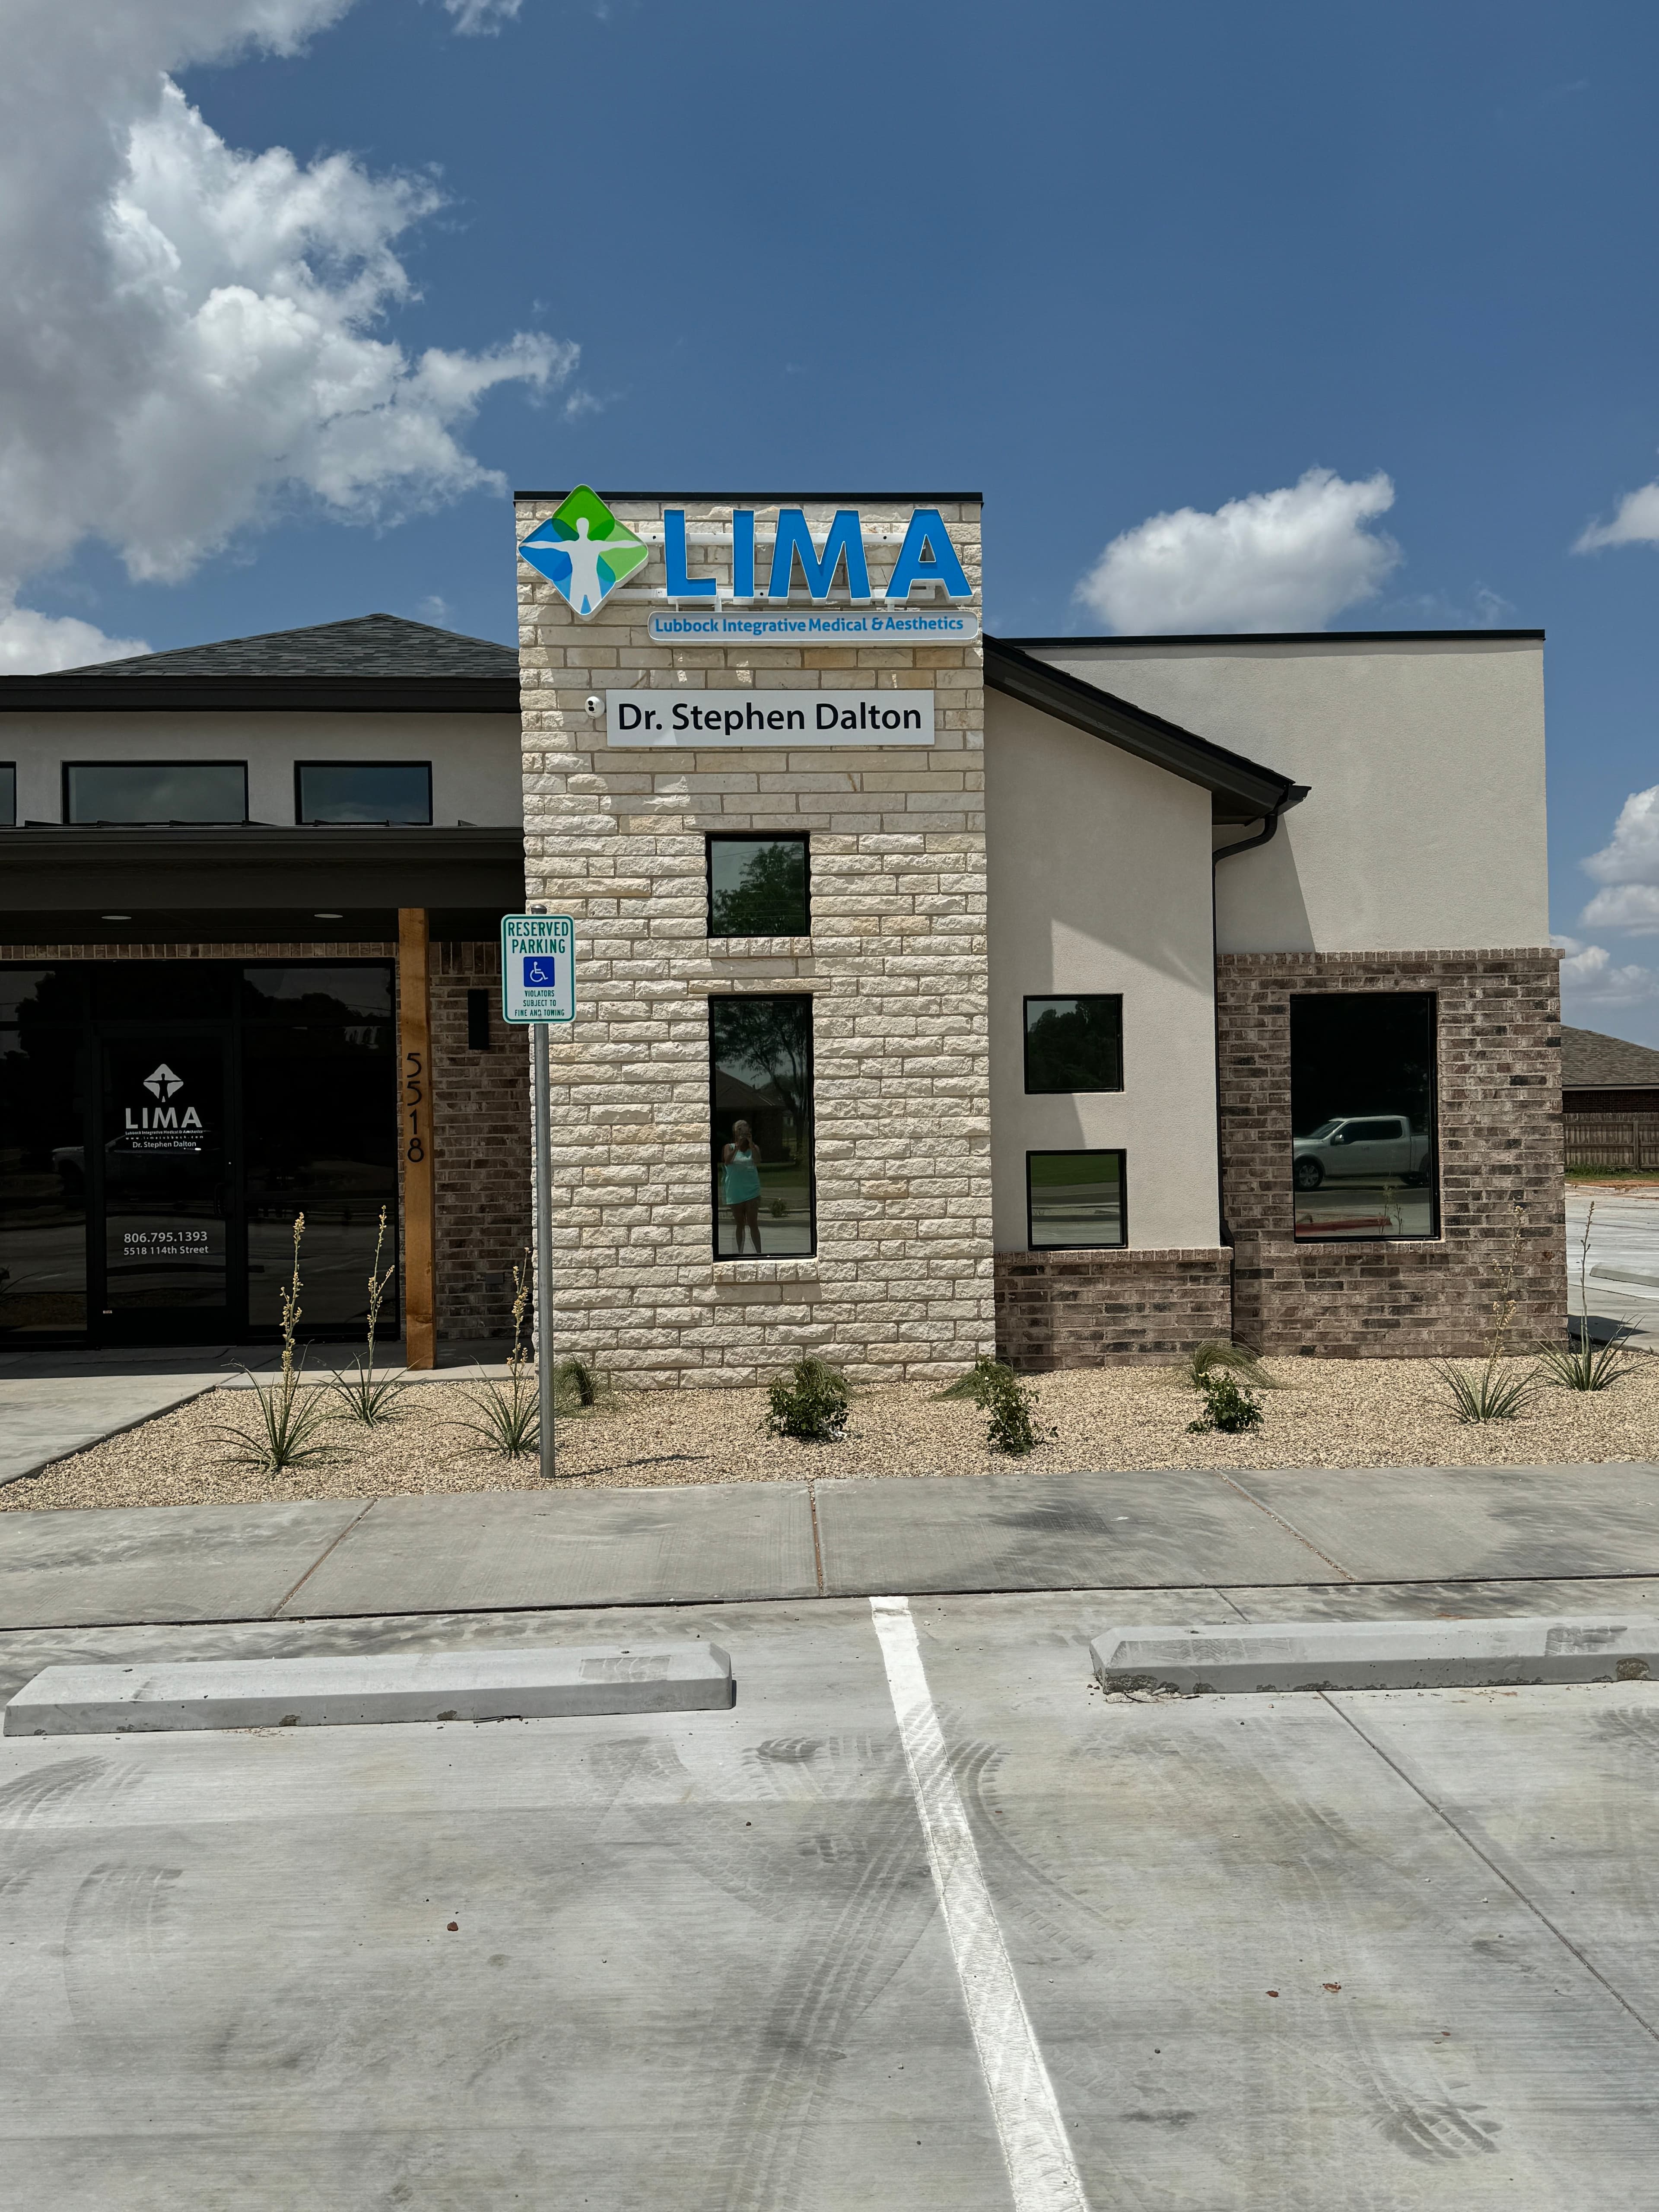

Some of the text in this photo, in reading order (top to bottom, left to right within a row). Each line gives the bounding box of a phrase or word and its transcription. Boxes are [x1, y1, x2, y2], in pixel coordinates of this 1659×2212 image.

[664, 509, 973, 604] LIMA
[655, 616, 964, 636] Lubbock Integrative Medical & Aesthetics
[618, 702, 922, 736] Dr. Stephen Dalton
[508, 922, 569, 937] RESERVED
[512, 939, 566, 953] PARKING
[407, 1052, 425, 1163] 5518
[125, 1107, 203, 1129] LIMA
[124, 1231, 207, 1243] 806.795.1393
[124, 1246, 209, 1255] 5518 114th Street
